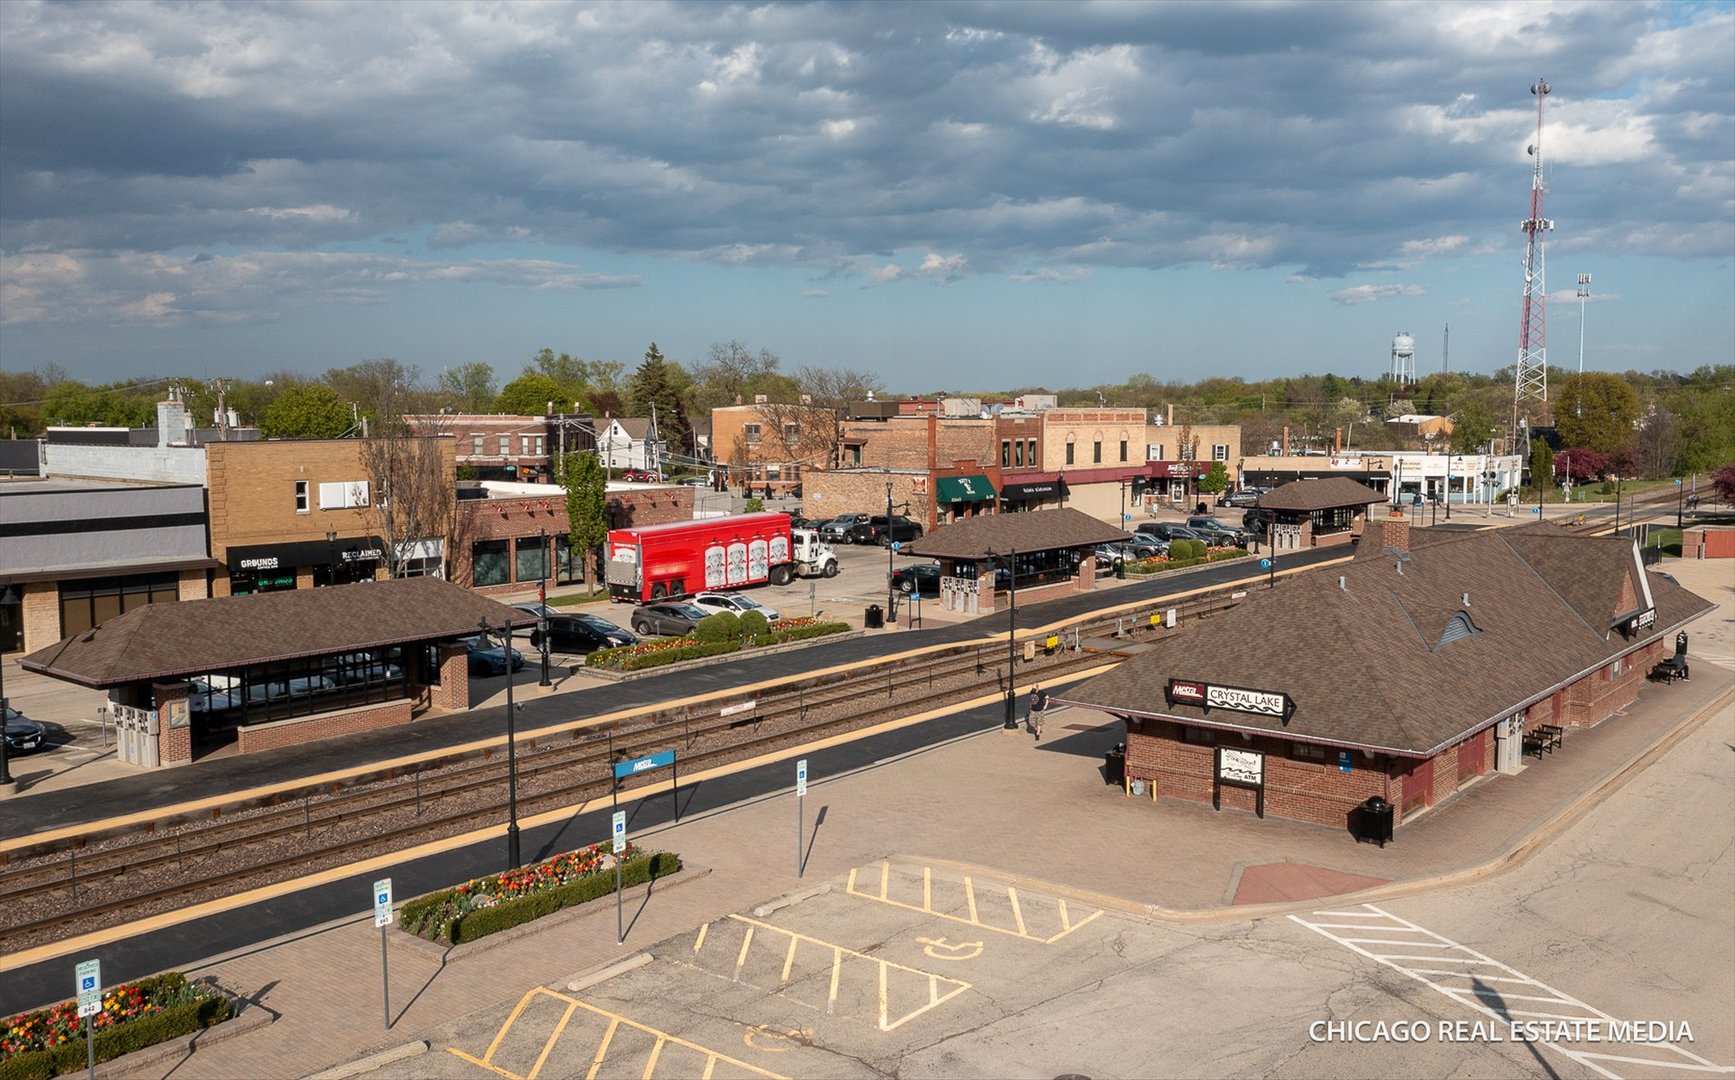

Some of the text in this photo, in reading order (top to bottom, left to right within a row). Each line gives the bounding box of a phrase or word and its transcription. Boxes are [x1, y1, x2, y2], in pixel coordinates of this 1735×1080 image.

[342, 549, 382, 559] RECLAIMED
[241, 557, 279, 568] GROUNDS
[1172, 685, 1203, 698] Metra
[1210, 689, 1280, 708] CRYSTAL LAKE
